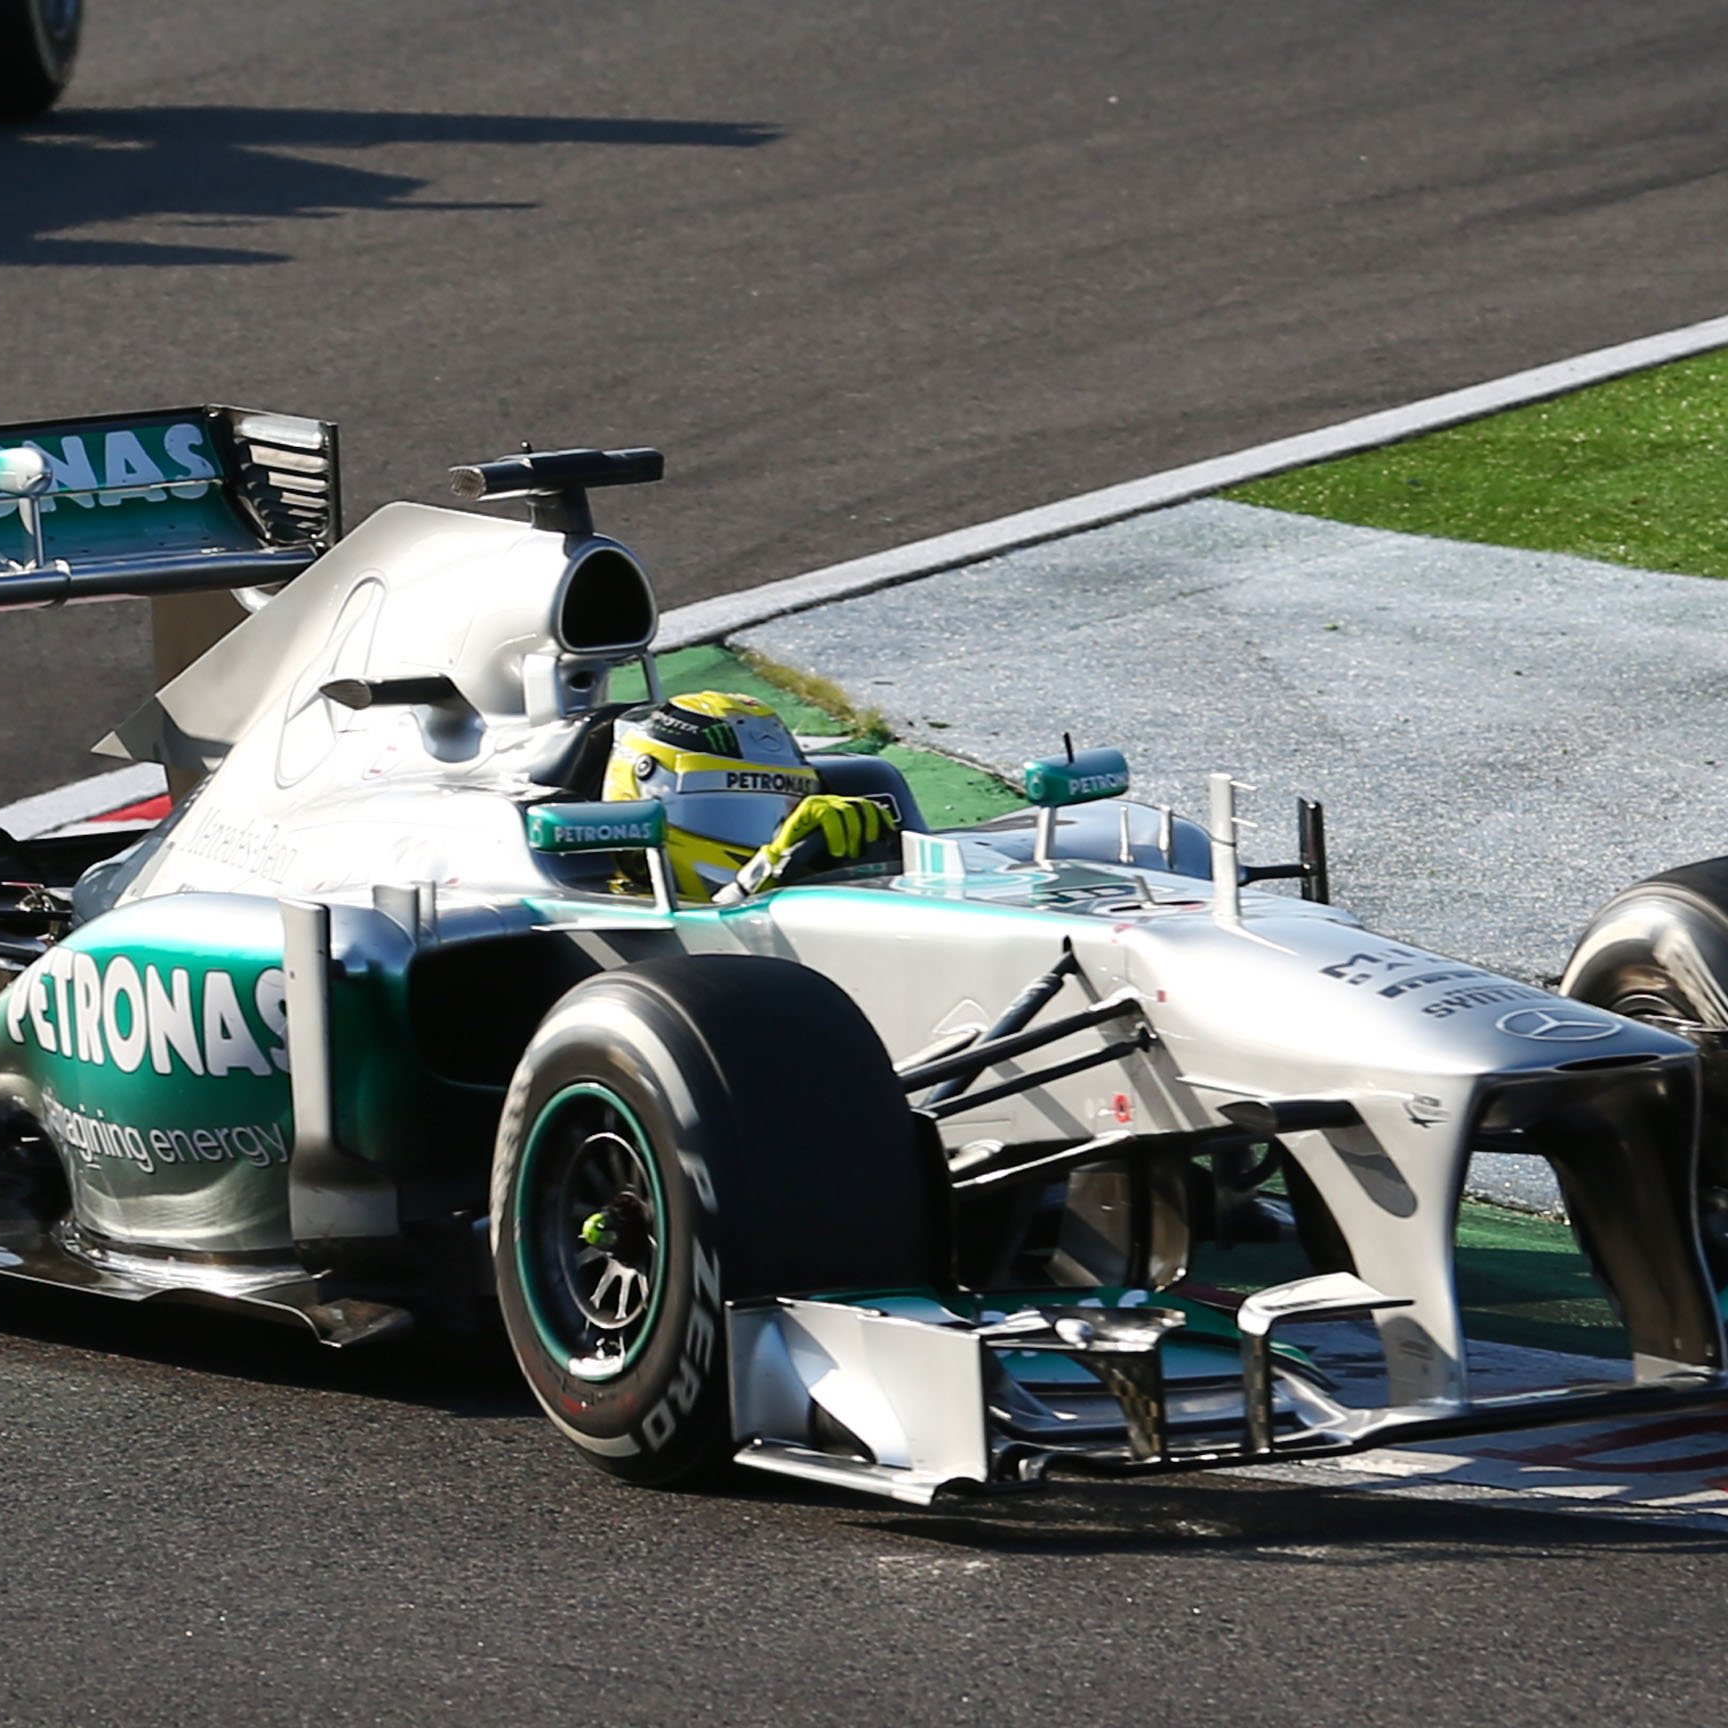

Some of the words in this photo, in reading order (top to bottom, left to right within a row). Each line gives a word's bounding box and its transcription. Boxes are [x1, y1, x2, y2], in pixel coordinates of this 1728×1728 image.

[553, 823, 653, 843] PETRONAS
[149, 1122, 289, 1168] energy
[641, 1234, 721, 1453] ZERO
